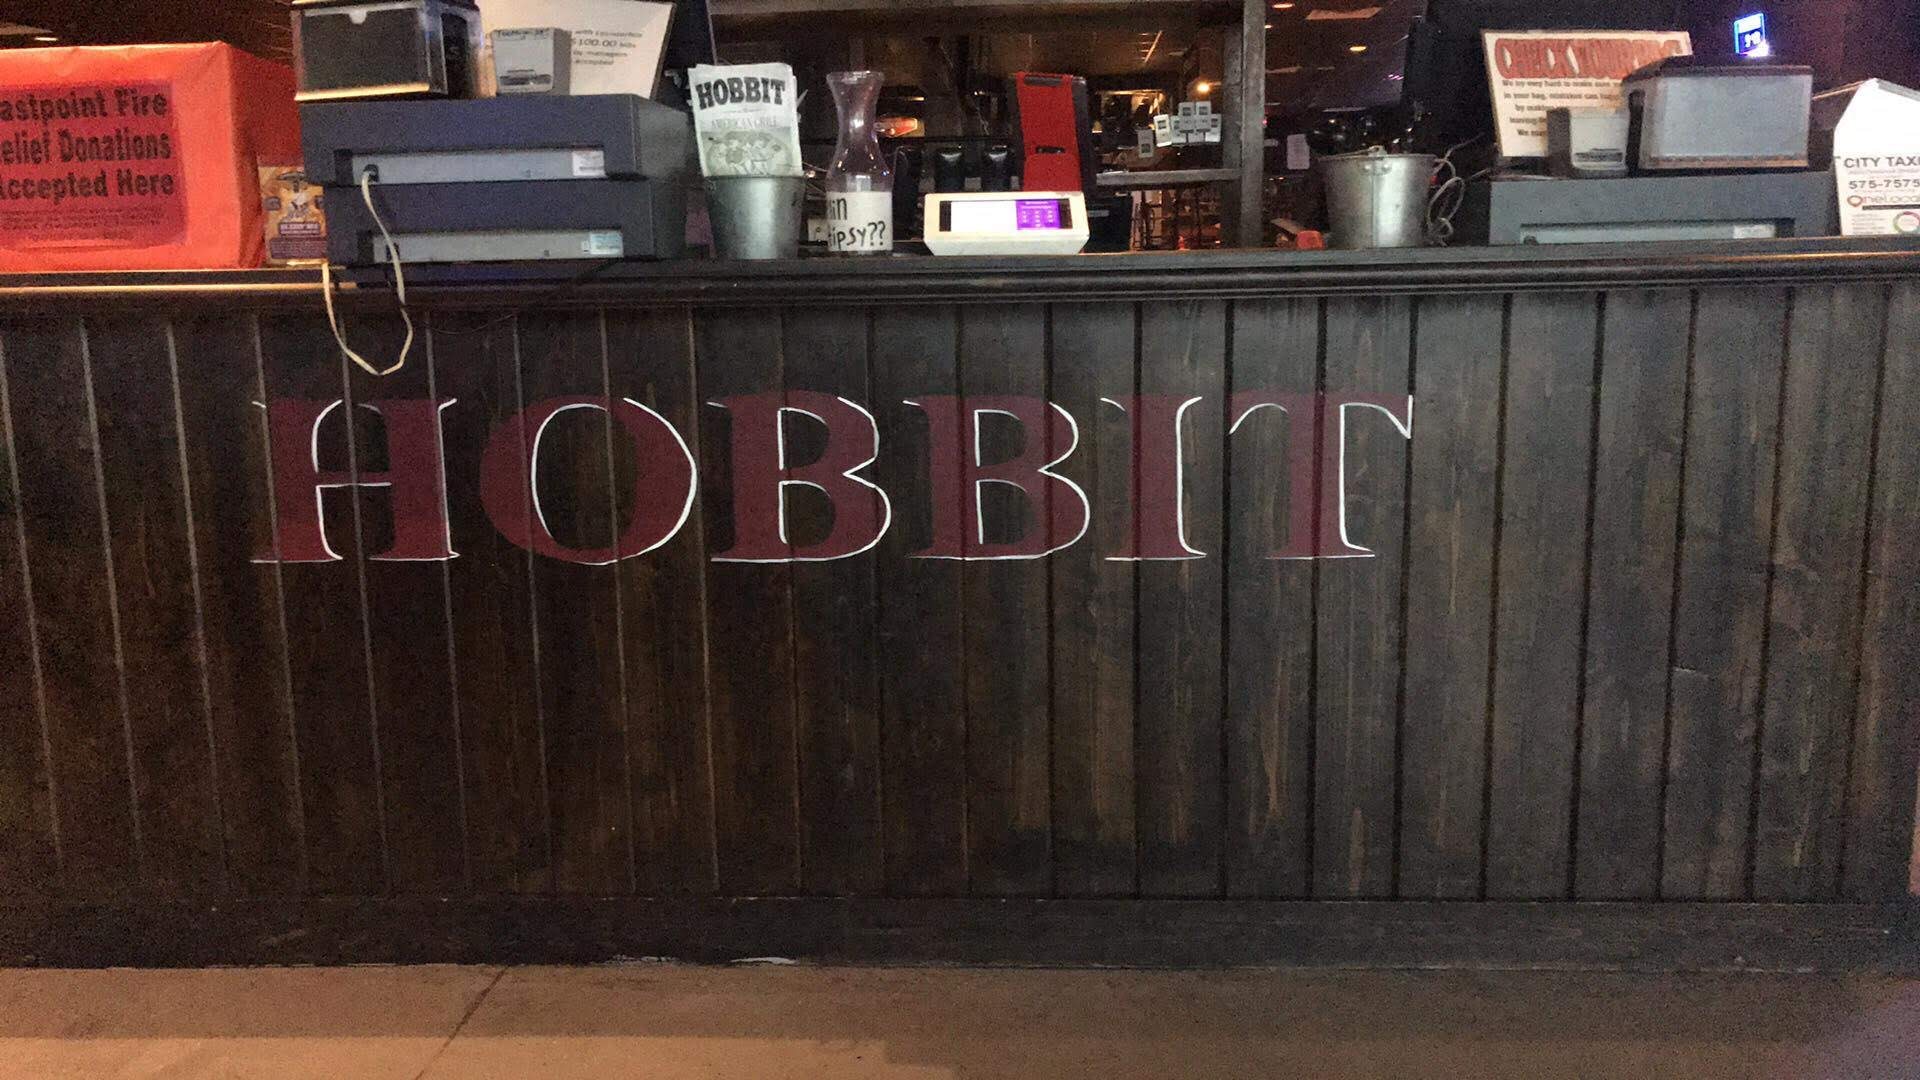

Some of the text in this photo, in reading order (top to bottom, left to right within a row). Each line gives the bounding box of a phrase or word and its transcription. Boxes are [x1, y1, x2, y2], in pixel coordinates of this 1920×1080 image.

[114, 88, 168, 116] Fire
[695, 76, 785, 110] HOBBIT
[58, 127, 172, 162] Donations
[1843, 156, 1881, 168] CITY
[117, 168, 174, 196] Here
[1848, 179, 1920, 190] 575-7575
[250, 389, 1414, 566] HOBBIT
